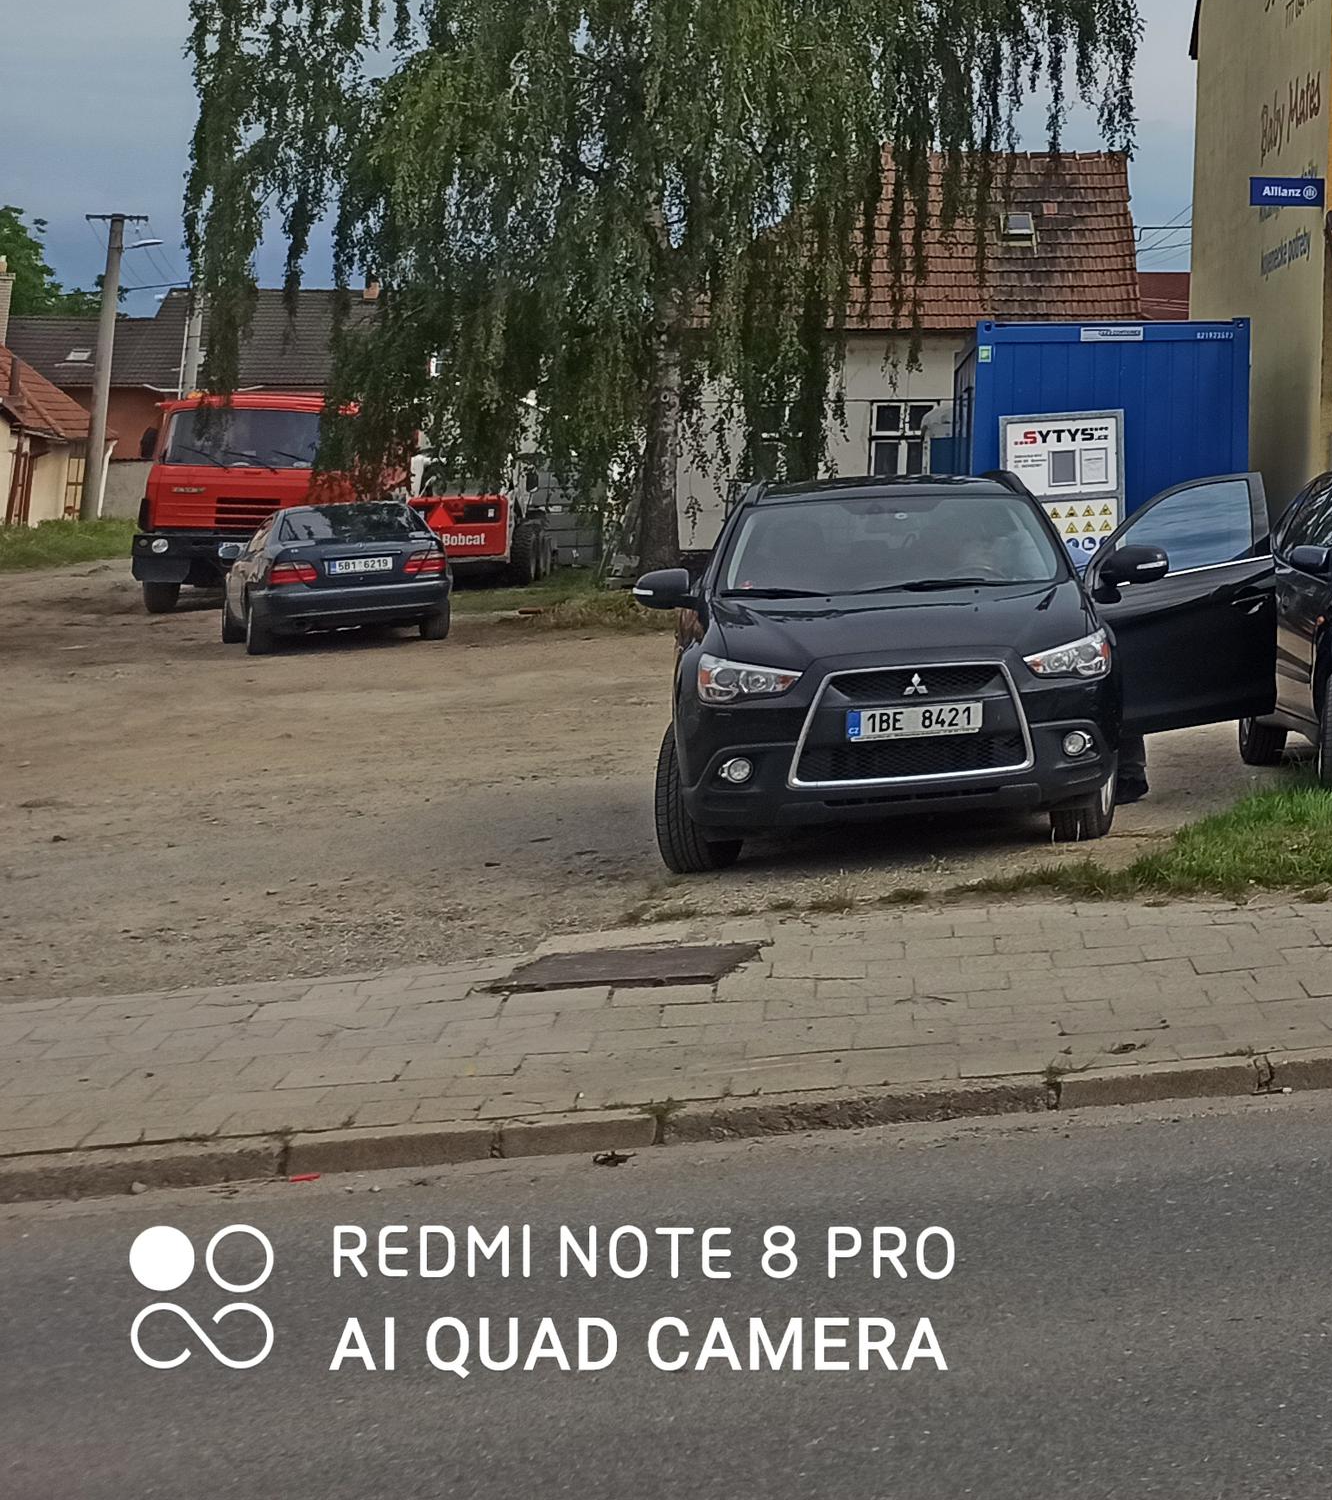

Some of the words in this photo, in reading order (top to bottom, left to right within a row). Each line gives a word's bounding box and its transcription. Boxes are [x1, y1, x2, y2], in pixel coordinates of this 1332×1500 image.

[1260, 90, 1285, 167] Baby
[1287, 71, 1321, 143] Mates
[1262, 185, 1301, 197] Allianz
[442, 533, 485, 546] Bobcat
[338, 562, 356, 571] 5B1
[363, 559, 388, 569] 6219
[867, 711, 904, 733] 1BE
[921, 706, 971, 729] 8421
